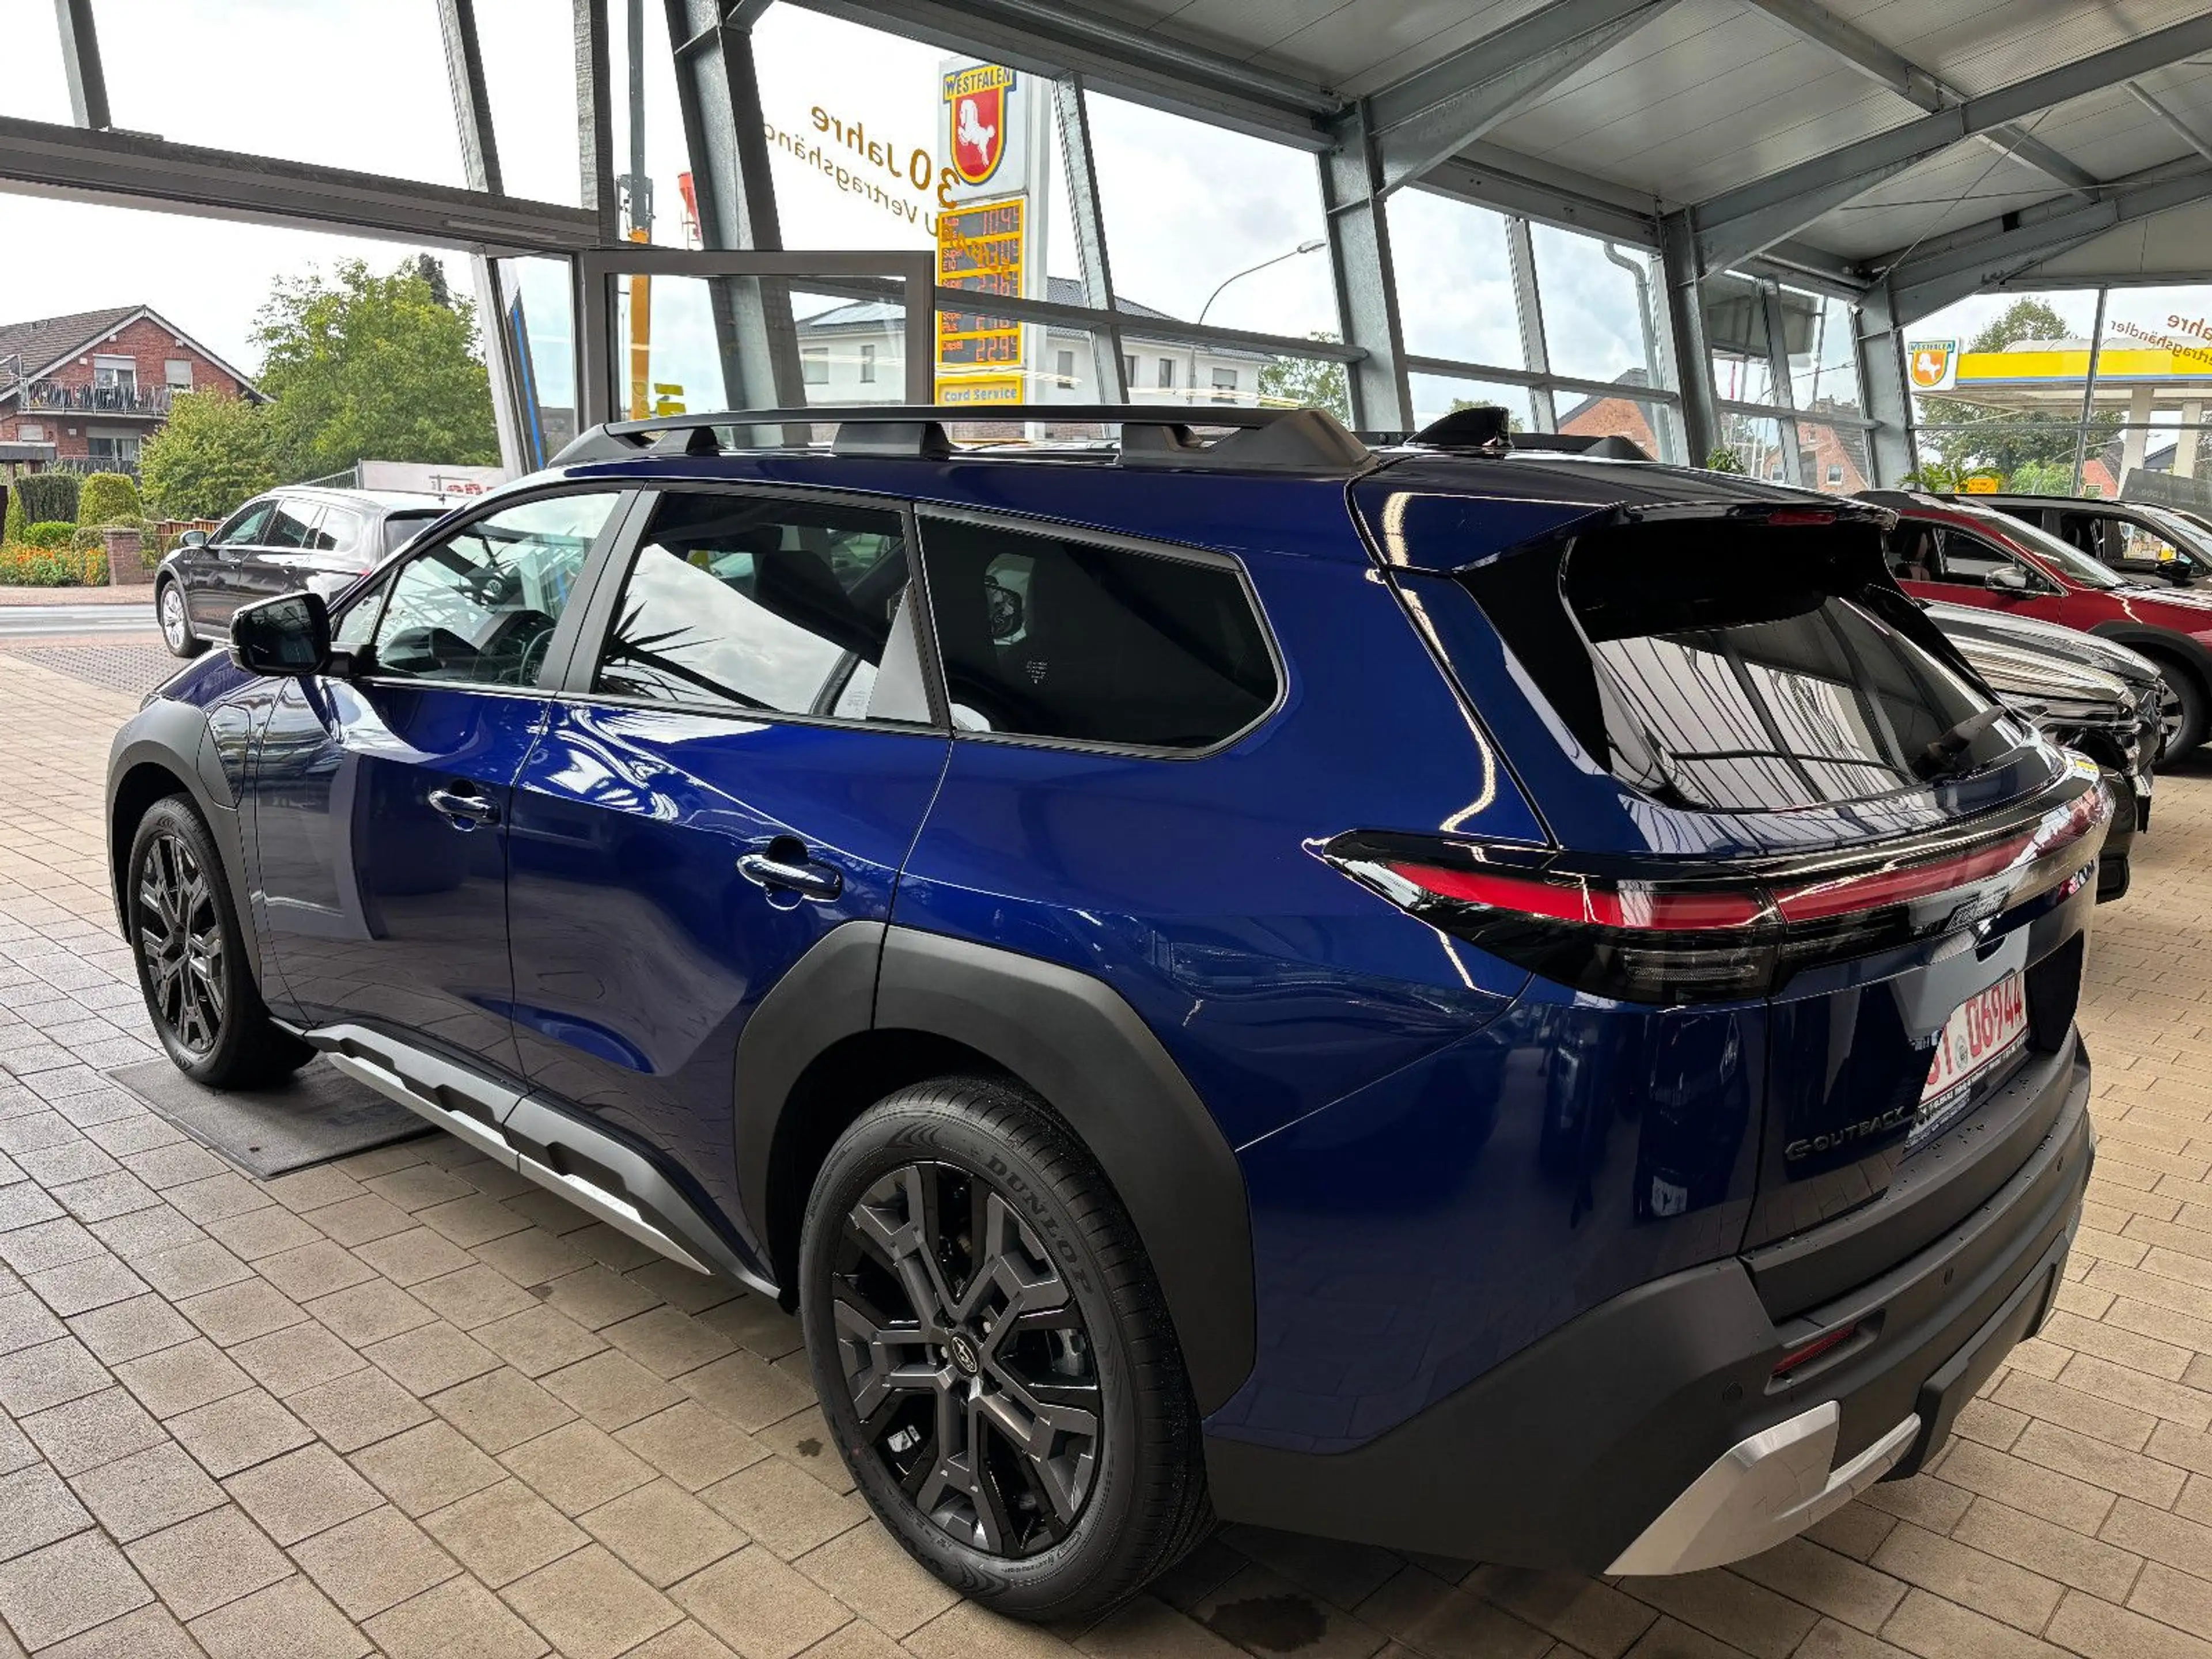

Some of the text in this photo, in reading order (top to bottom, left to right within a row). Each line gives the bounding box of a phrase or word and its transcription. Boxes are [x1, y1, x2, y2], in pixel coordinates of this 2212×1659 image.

[945, 67, 1010, 97] WESTFALEN
[945, 387, 1018, 402] Card Service
[986, 1154, 1094, 1295] DUNLOP
